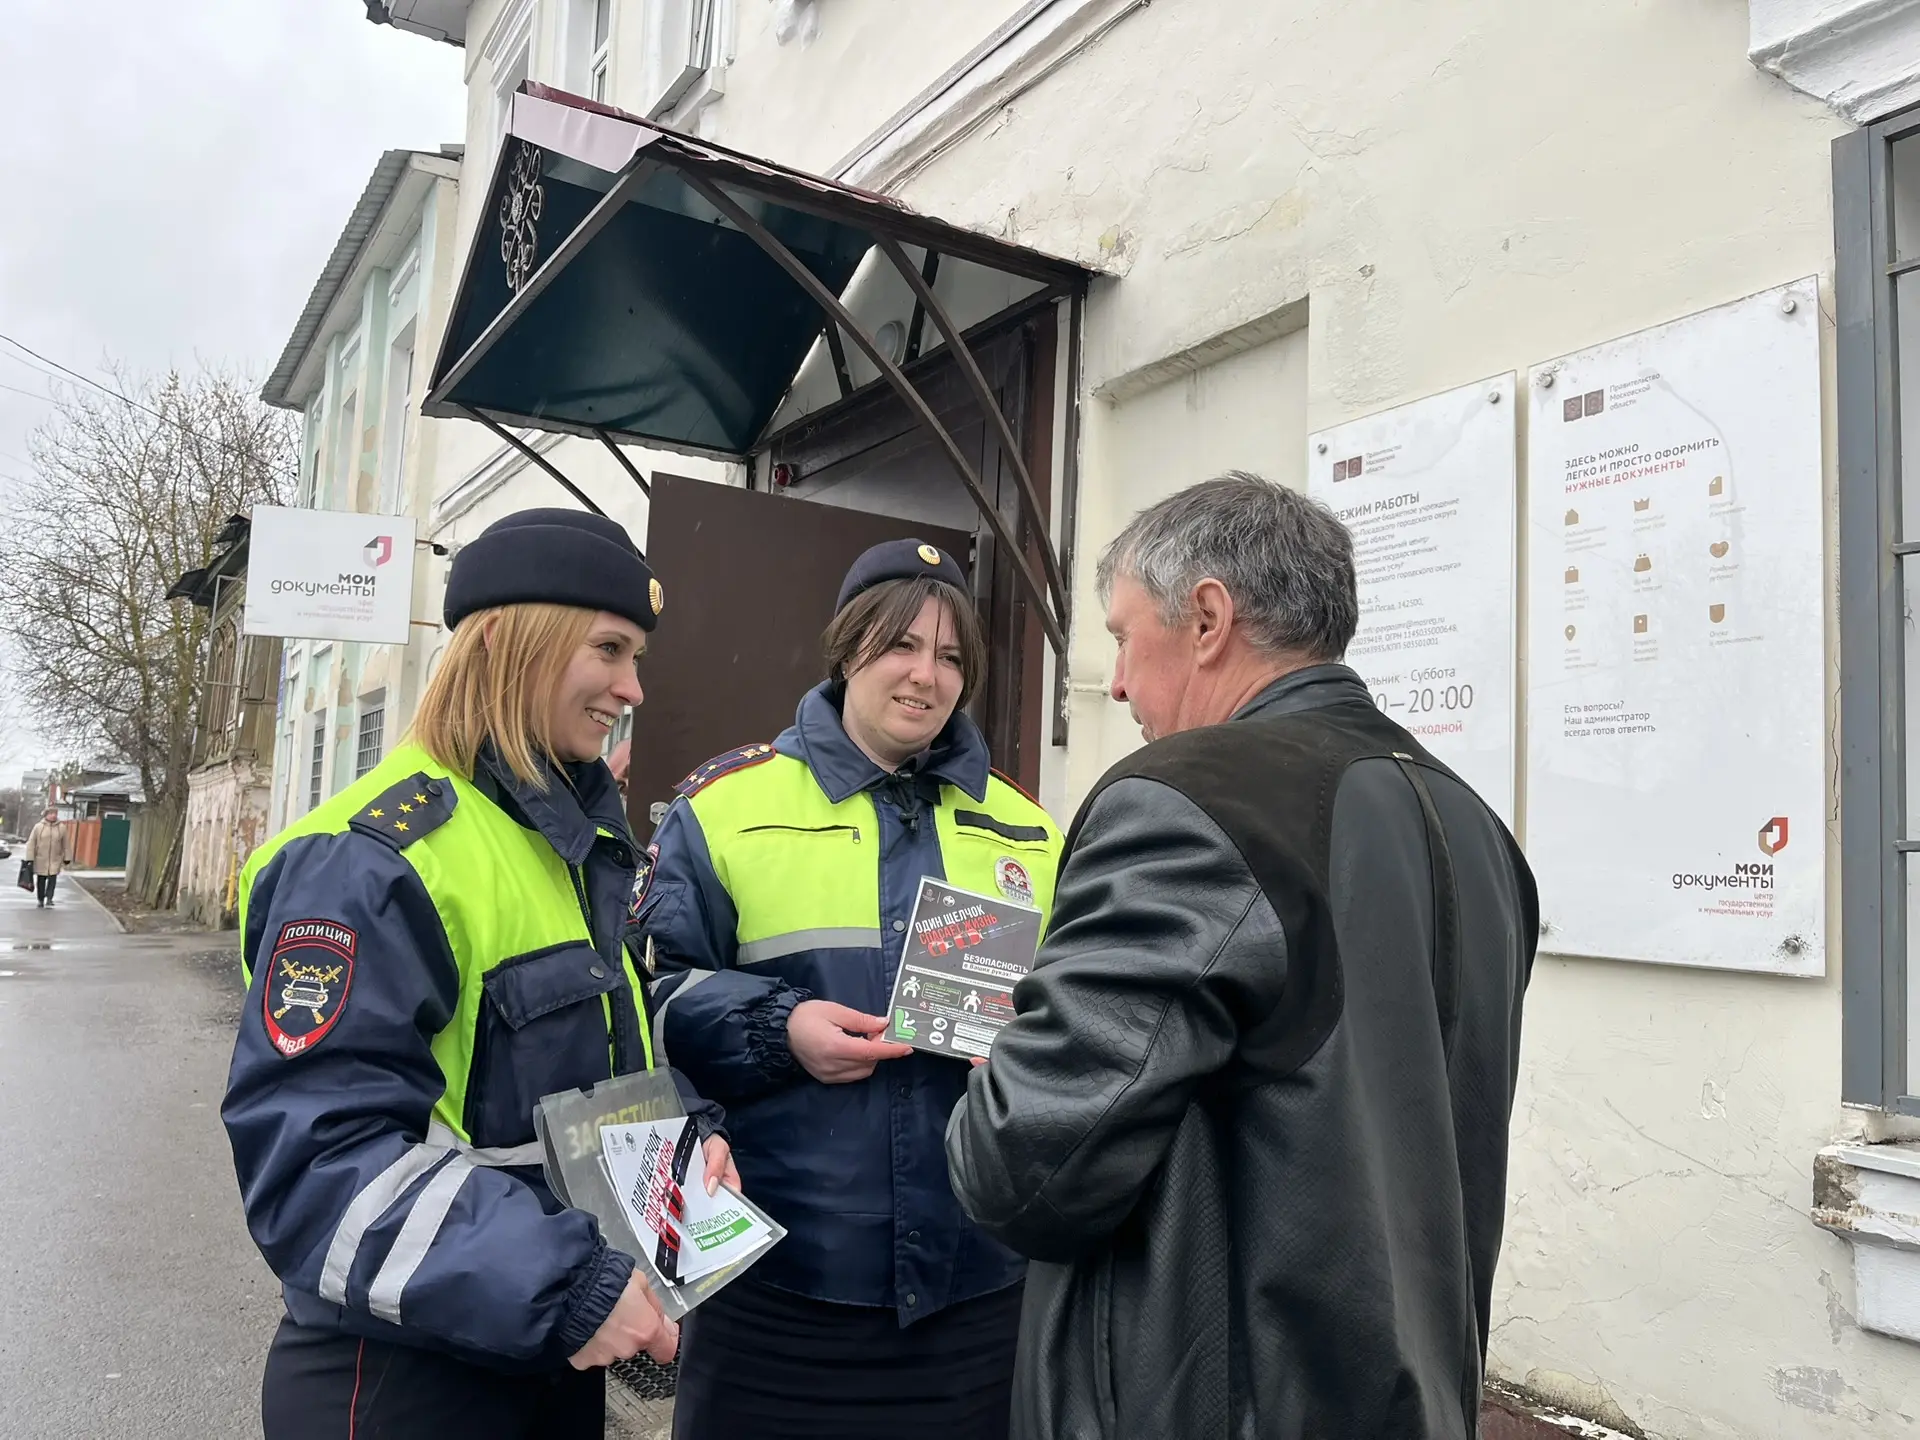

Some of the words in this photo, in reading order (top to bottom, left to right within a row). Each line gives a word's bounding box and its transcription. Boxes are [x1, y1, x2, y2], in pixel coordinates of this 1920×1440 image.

[1609, 373, 1661, 392] Правительство
[1609, 384, 1651, 401] Московской
[1609, 398, 1637, 411] области
[1565, 456, 1596, 469] ЗДЕСЬ
[1599, 443, 1639, 462] МОЖНО
[1565, 467, 1597, 482] ЛЕГКО
[1600, 464, 1607, 474] И
[1609, 453, 1652, 471] ПРОСТО
[1654, 437, 1720, 460] ОФОРМИТЬ
[1565, 475, 1611, 494] НУЖНЫЕ
[1613, 459, 1686, 485] ДОКУМЕНТЫ
[1374, 490, 1420, 514] РАБОТЫ
[1434, 509, 1457, 521] округа
[1410, 667, 1456, 684] Суббота
[1564, 704, 1582, 714] Есть
[1583, 700, 1625, 713] вопросы?
[1564, 716, 1582, 725] Наш
[1584, 711, 1651, 726] администратор
[1564, 728, 1591, 738] всегда
[1593, 725, 1616, 736] готов
[1617, 723, 1656, 735] ответить
[1672, 873, 1774, 891] документы
[1717, 898, 1774, 910] государственных
[1753, 891, 1774, 902] центр
[915, 916, 944, 934] ОДИН
[943, 904, 986, 926] ЩЕЛЧОК
[1703, 906, 1755, 917] муниципальных
[1755, 909, 1774, 919] услуг
[284, 925, 352, 947] ПОЛИЦИЯ
[919, 924, 962, 945] СПАСАЕТ
[962, 913, 999, 932] ЖИЗНЬ
[964, 953, 1029, 974] БЕЗОПАСНОСТЬ
[276, 1033, 308, 1054] МВД
[639, 1125, 662, 1183] ЩЕЛЧОК
[631, 1173, 650, 1216] ОДИН
[644, 1174, 666, 1234] СПАСАЕТ
[655, 1137, 675, 1180] ЖИЗНЬ
[686, 1208, 740, 1237] БЕЗОПАСНОСТЬ
